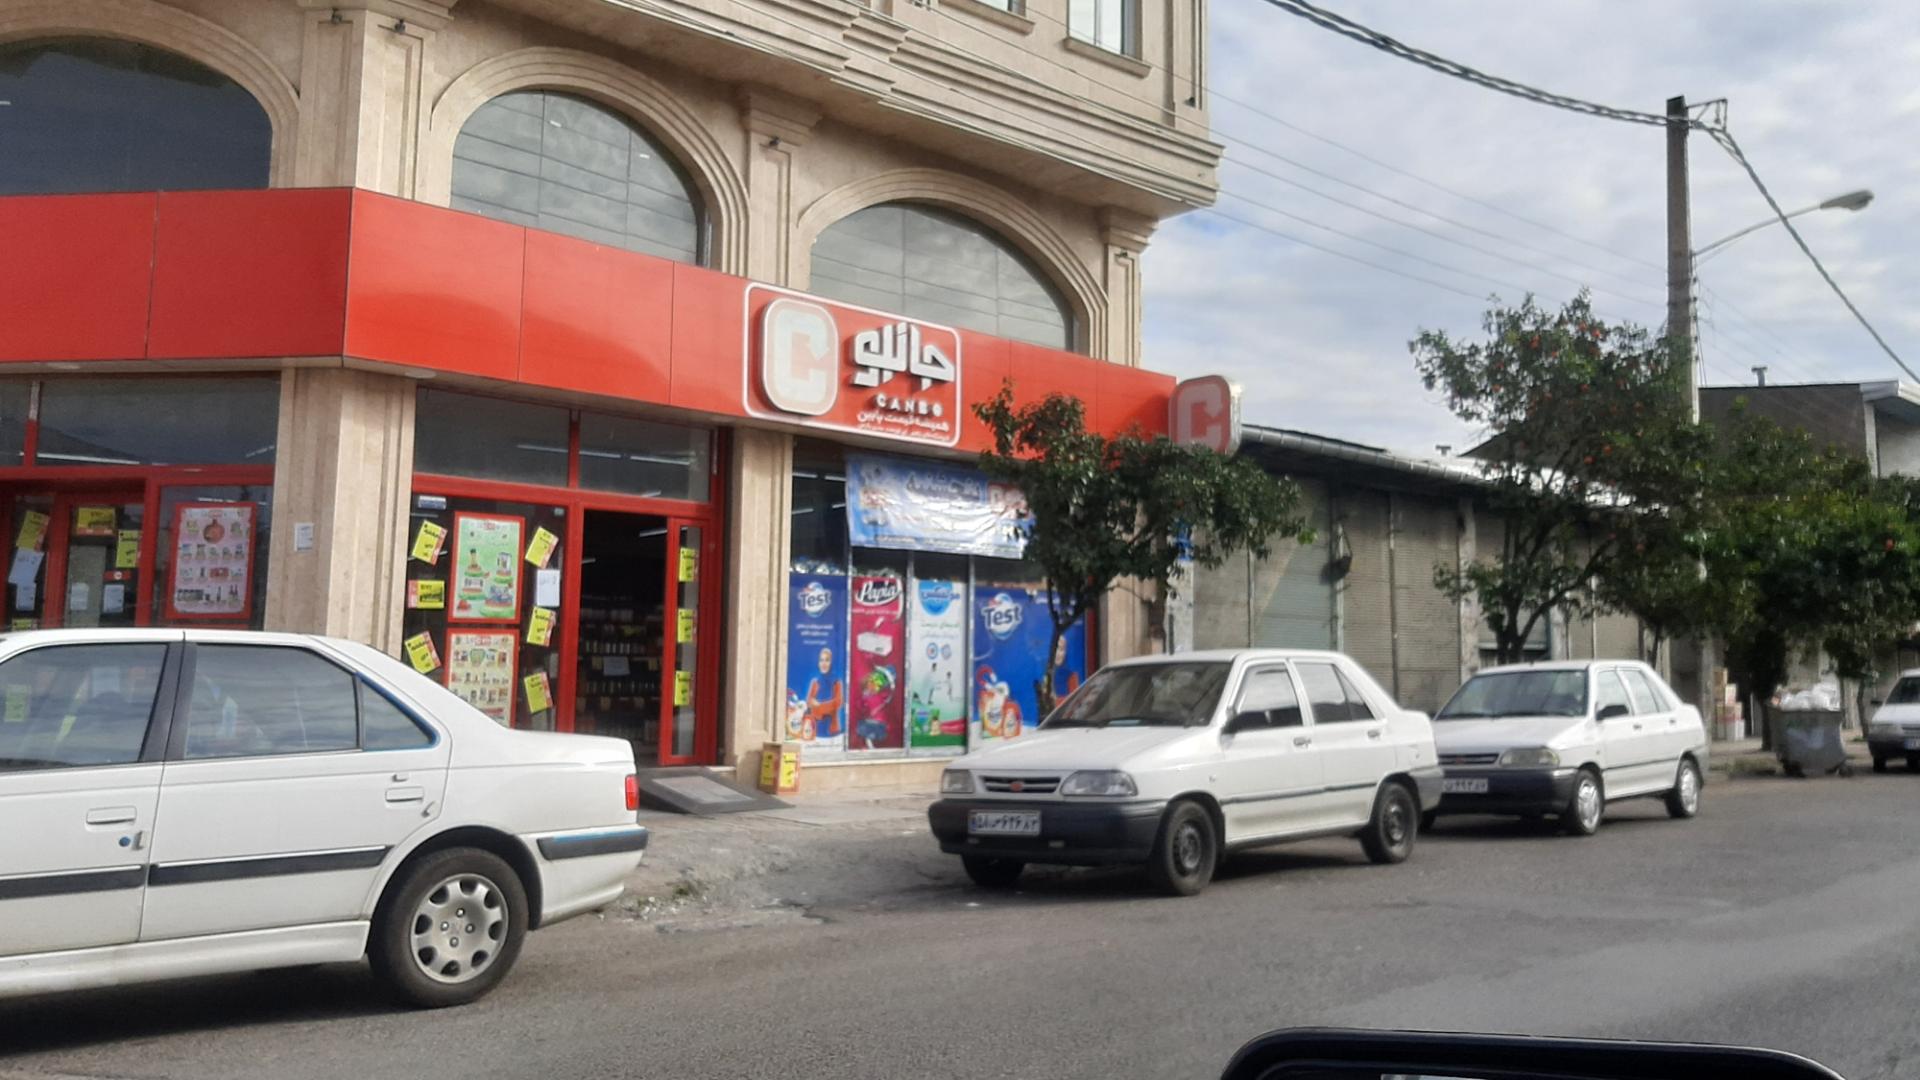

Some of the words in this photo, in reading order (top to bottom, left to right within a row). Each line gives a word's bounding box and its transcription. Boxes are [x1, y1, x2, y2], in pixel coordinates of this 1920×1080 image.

[854, 321, 955, 392] جانبو
[876, 393, 943, 417] CANBO
[799, 592, 830, 610] Test
[860, 580, 897, 603] Papia
[984, 605, 1021, 628] Test
